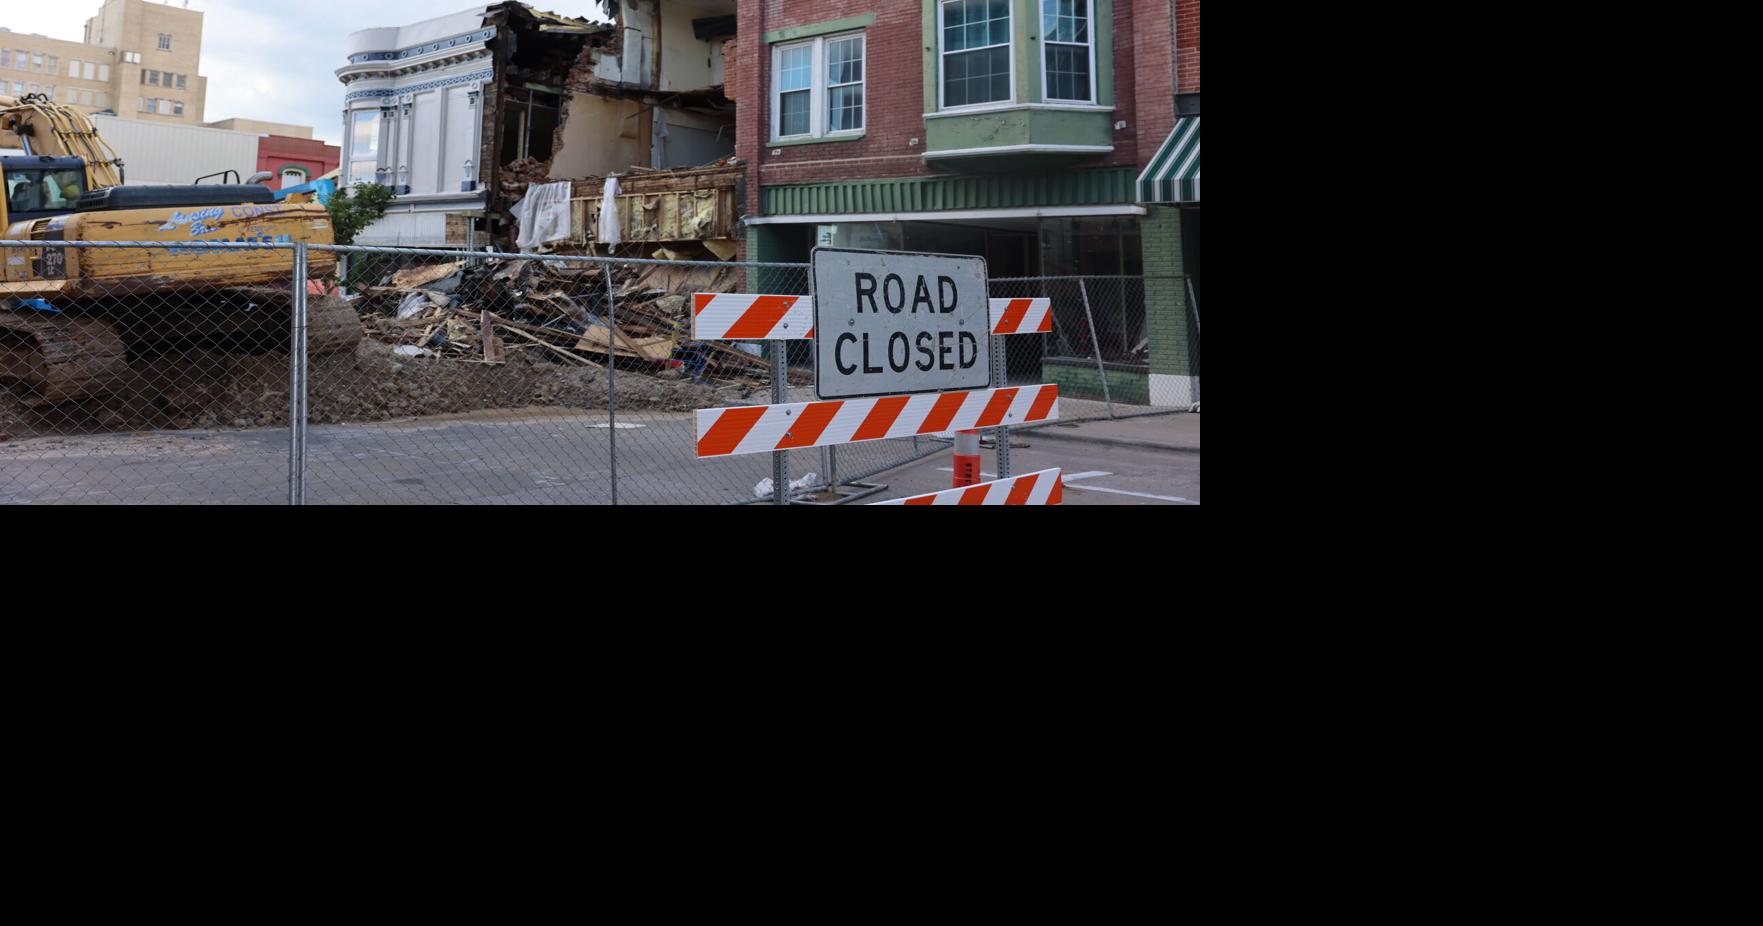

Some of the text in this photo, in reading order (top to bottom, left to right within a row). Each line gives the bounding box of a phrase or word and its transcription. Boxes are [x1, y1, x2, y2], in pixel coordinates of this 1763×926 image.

[47, 252, 63, 265] 270
[855, 272, 958, 314] ROAD
[835, 330, 978, 375] CLOSED
